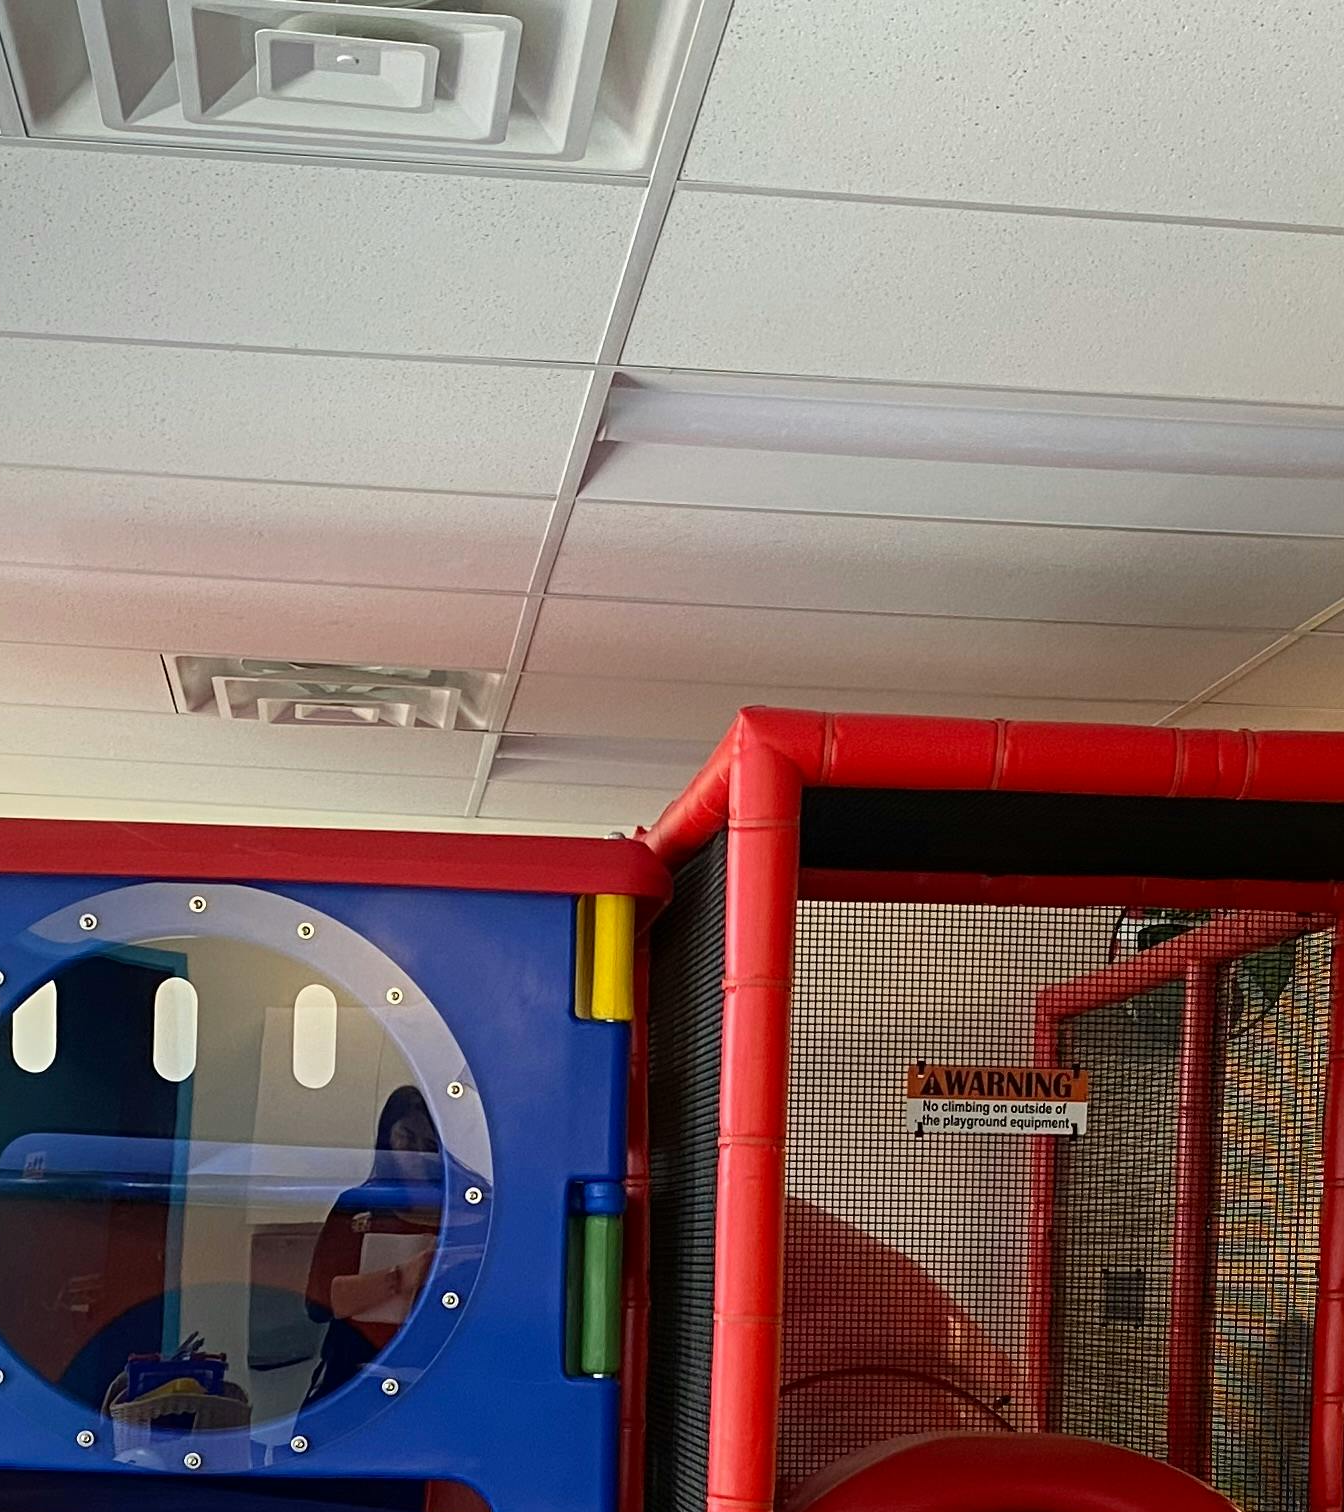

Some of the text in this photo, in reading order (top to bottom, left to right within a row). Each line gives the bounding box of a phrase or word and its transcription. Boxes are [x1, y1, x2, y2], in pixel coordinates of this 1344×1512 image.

[944, 1069, 1073, 1098] WARNING
[922, 1100, 1068, 1115] No climbing on outside of
[922, 1115, 1070, 1130] the playground equipment
